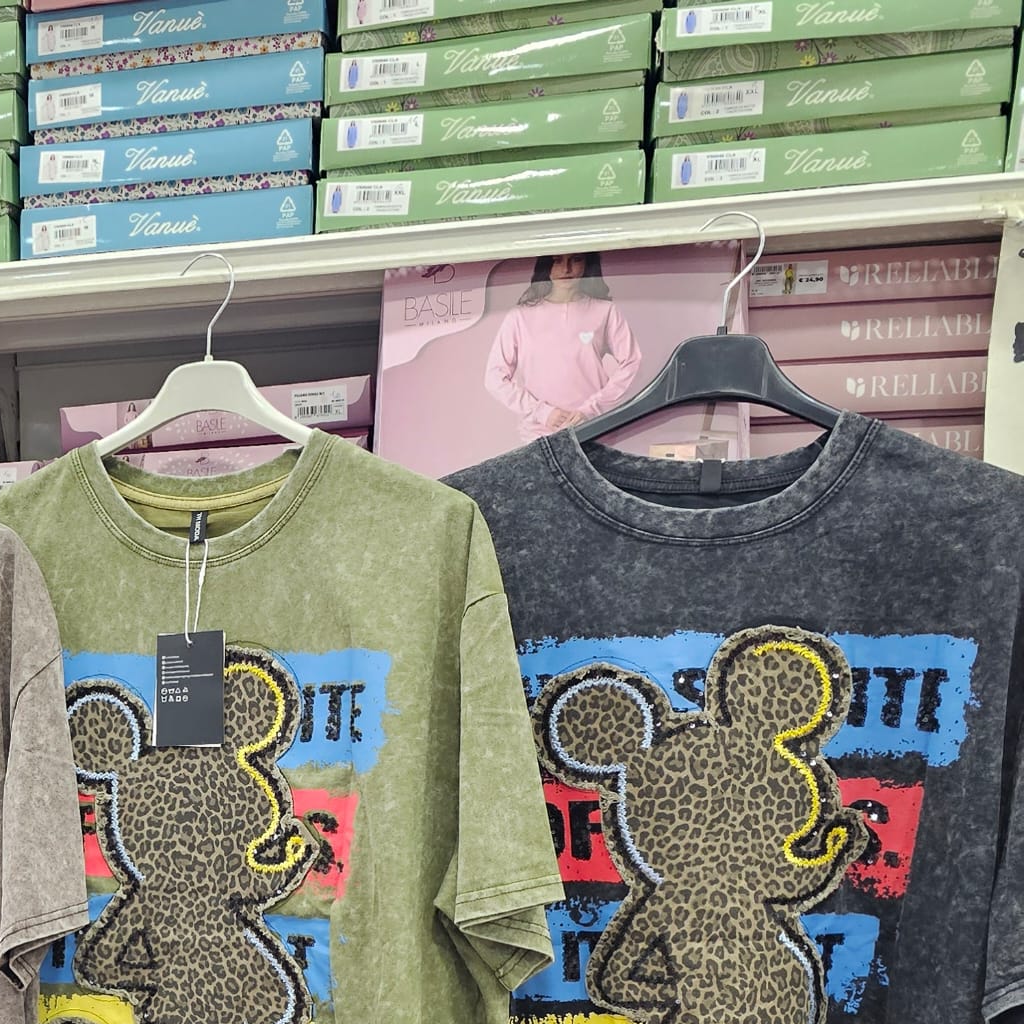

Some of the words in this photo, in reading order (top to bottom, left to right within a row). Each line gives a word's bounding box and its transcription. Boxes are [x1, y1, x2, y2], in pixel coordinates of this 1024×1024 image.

[133, 9, 204, 37] Vanuè
[796, 2, 882, 26] Vanuè
[136, 79, 207, 105] Vanuè
[787, 78, 872, 107] Vanuè
[125, 147, 195, 172] Vanuè
[784, 148, 870, 175] Vanuè
[129, 212, 199, 237] Vanuè
[404, 289, 473, 321] BASILE
[866, 313, 991, 340] RELIABL
